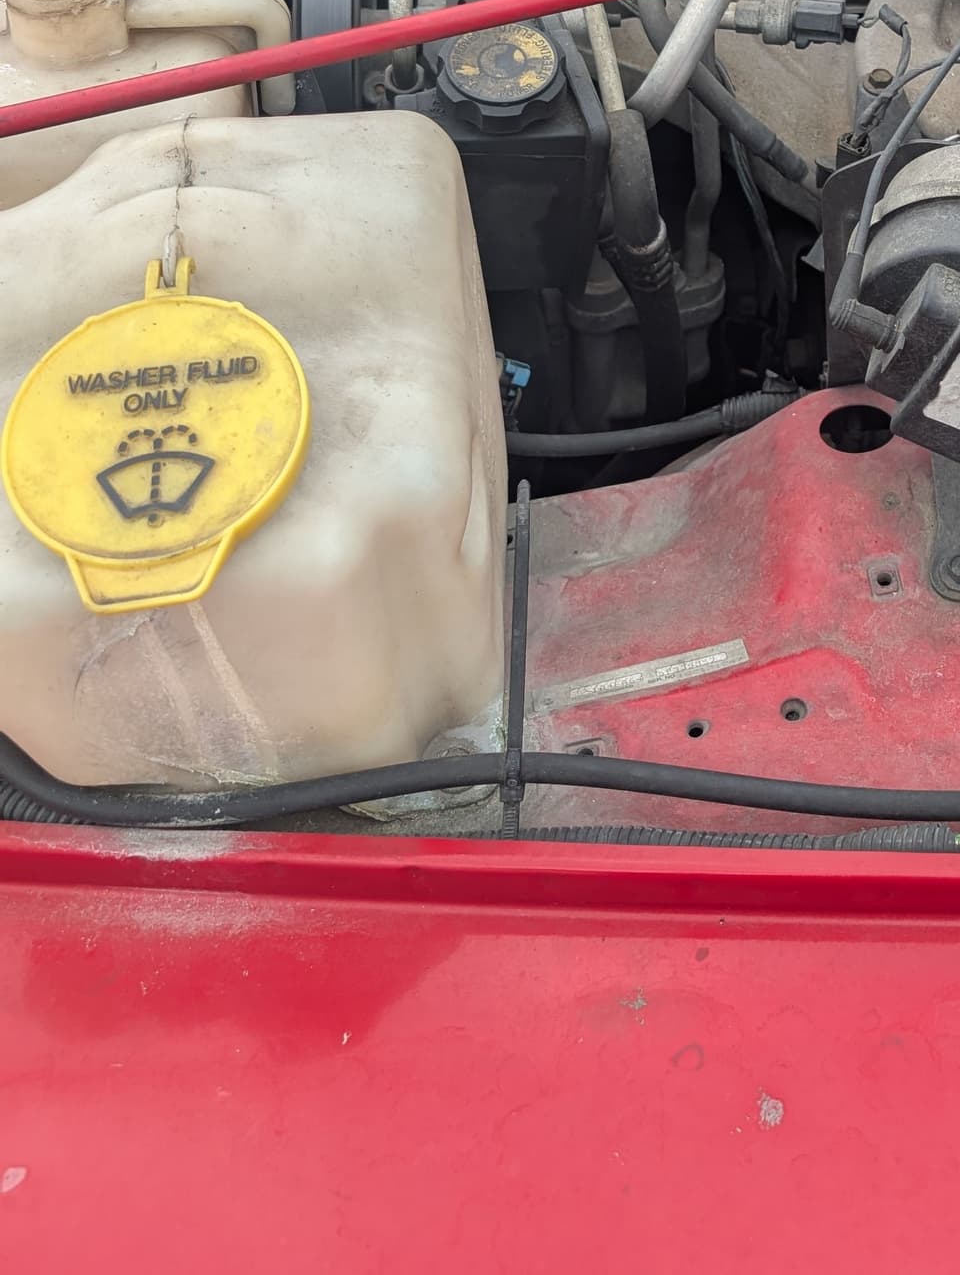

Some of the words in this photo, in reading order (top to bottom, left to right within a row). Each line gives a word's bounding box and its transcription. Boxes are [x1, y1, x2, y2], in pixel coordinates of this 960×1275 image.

[67, 364, 177, 394] WASHER
[187, 356, 258, 383] FLUID
[123, 387, 189, 413] ONLY
